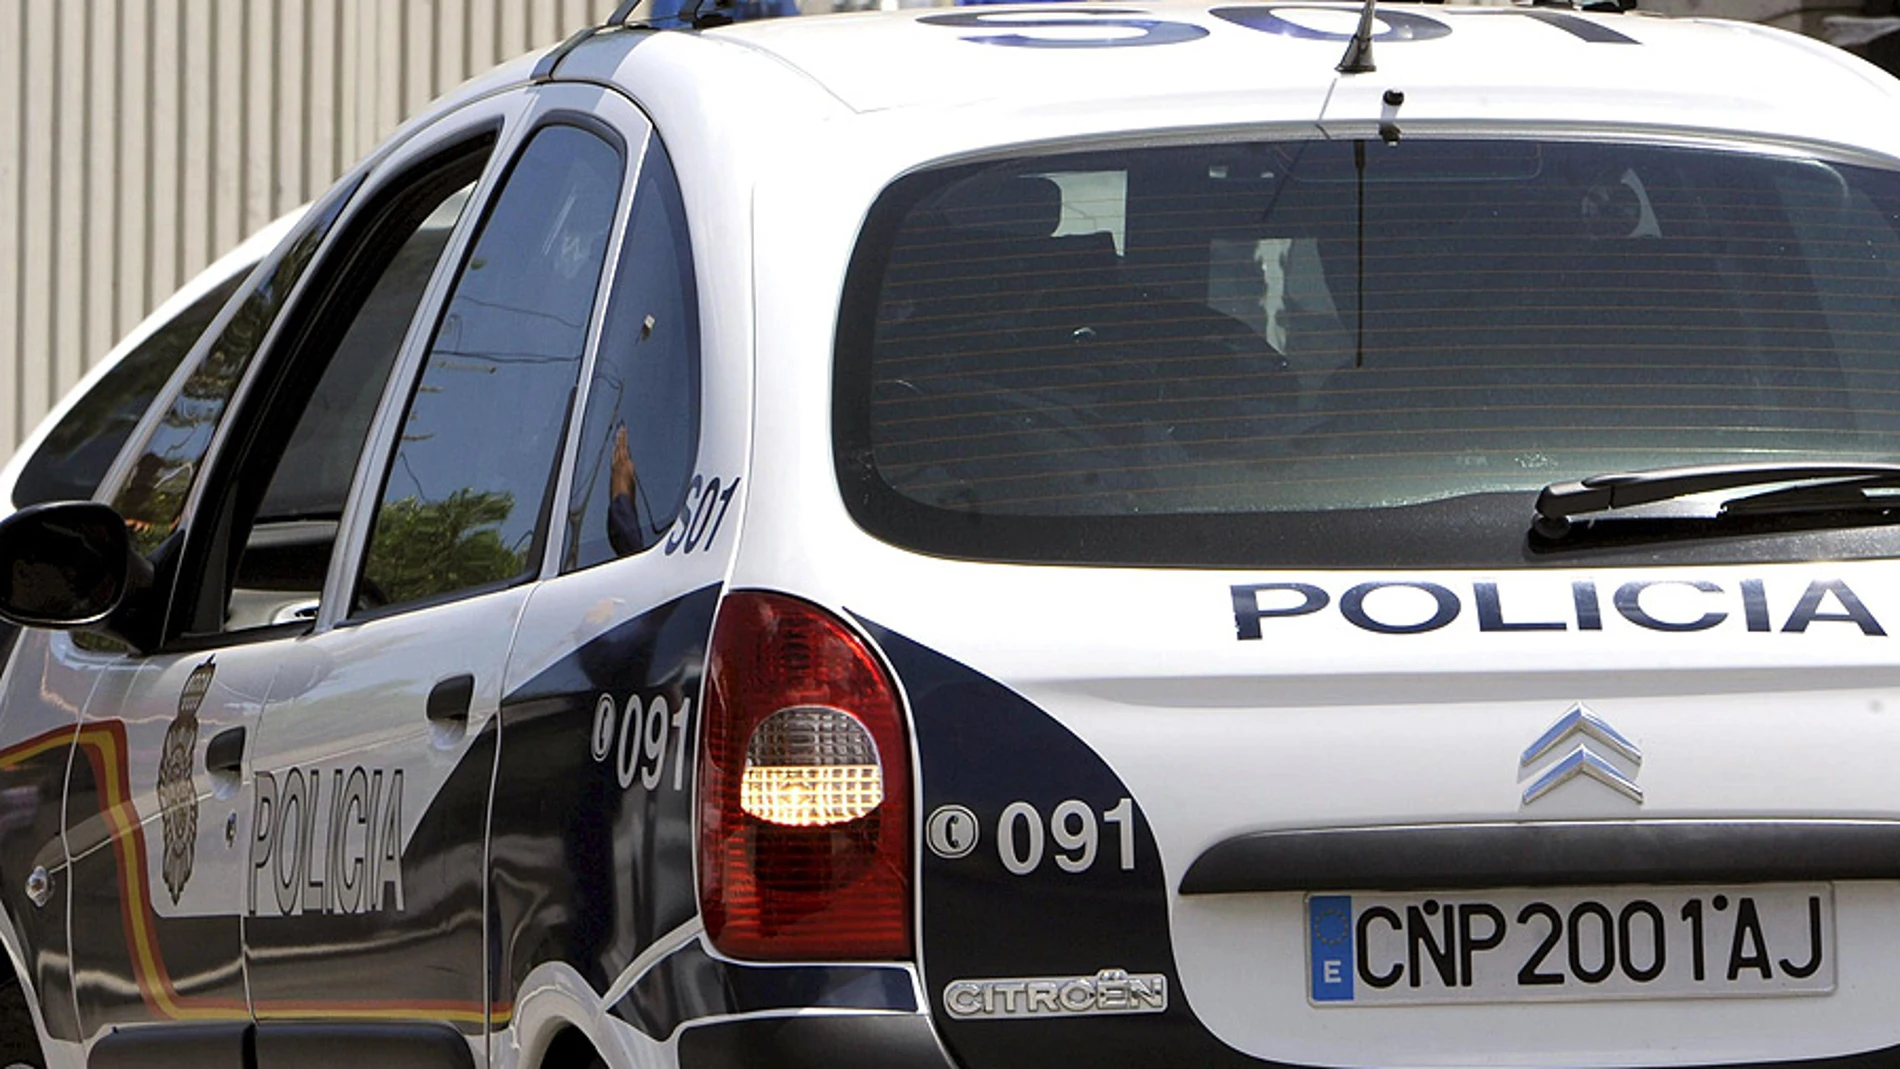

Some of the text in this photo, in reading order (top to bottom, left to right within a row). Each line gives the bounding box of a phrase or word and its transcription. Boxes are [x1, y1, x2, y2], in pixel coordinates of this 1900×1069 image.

[664, 473, 741, 556] S01
[1229, 577, 1888, 640] POLICIA
[617, 693, 691, 791] 091
[247, 766, 405, 916] POLICIA
[997, 797, 1135, 876] 091
[945, 969, 1166, 1018] CITROËN
[1323, 960, 1341, 984] E
